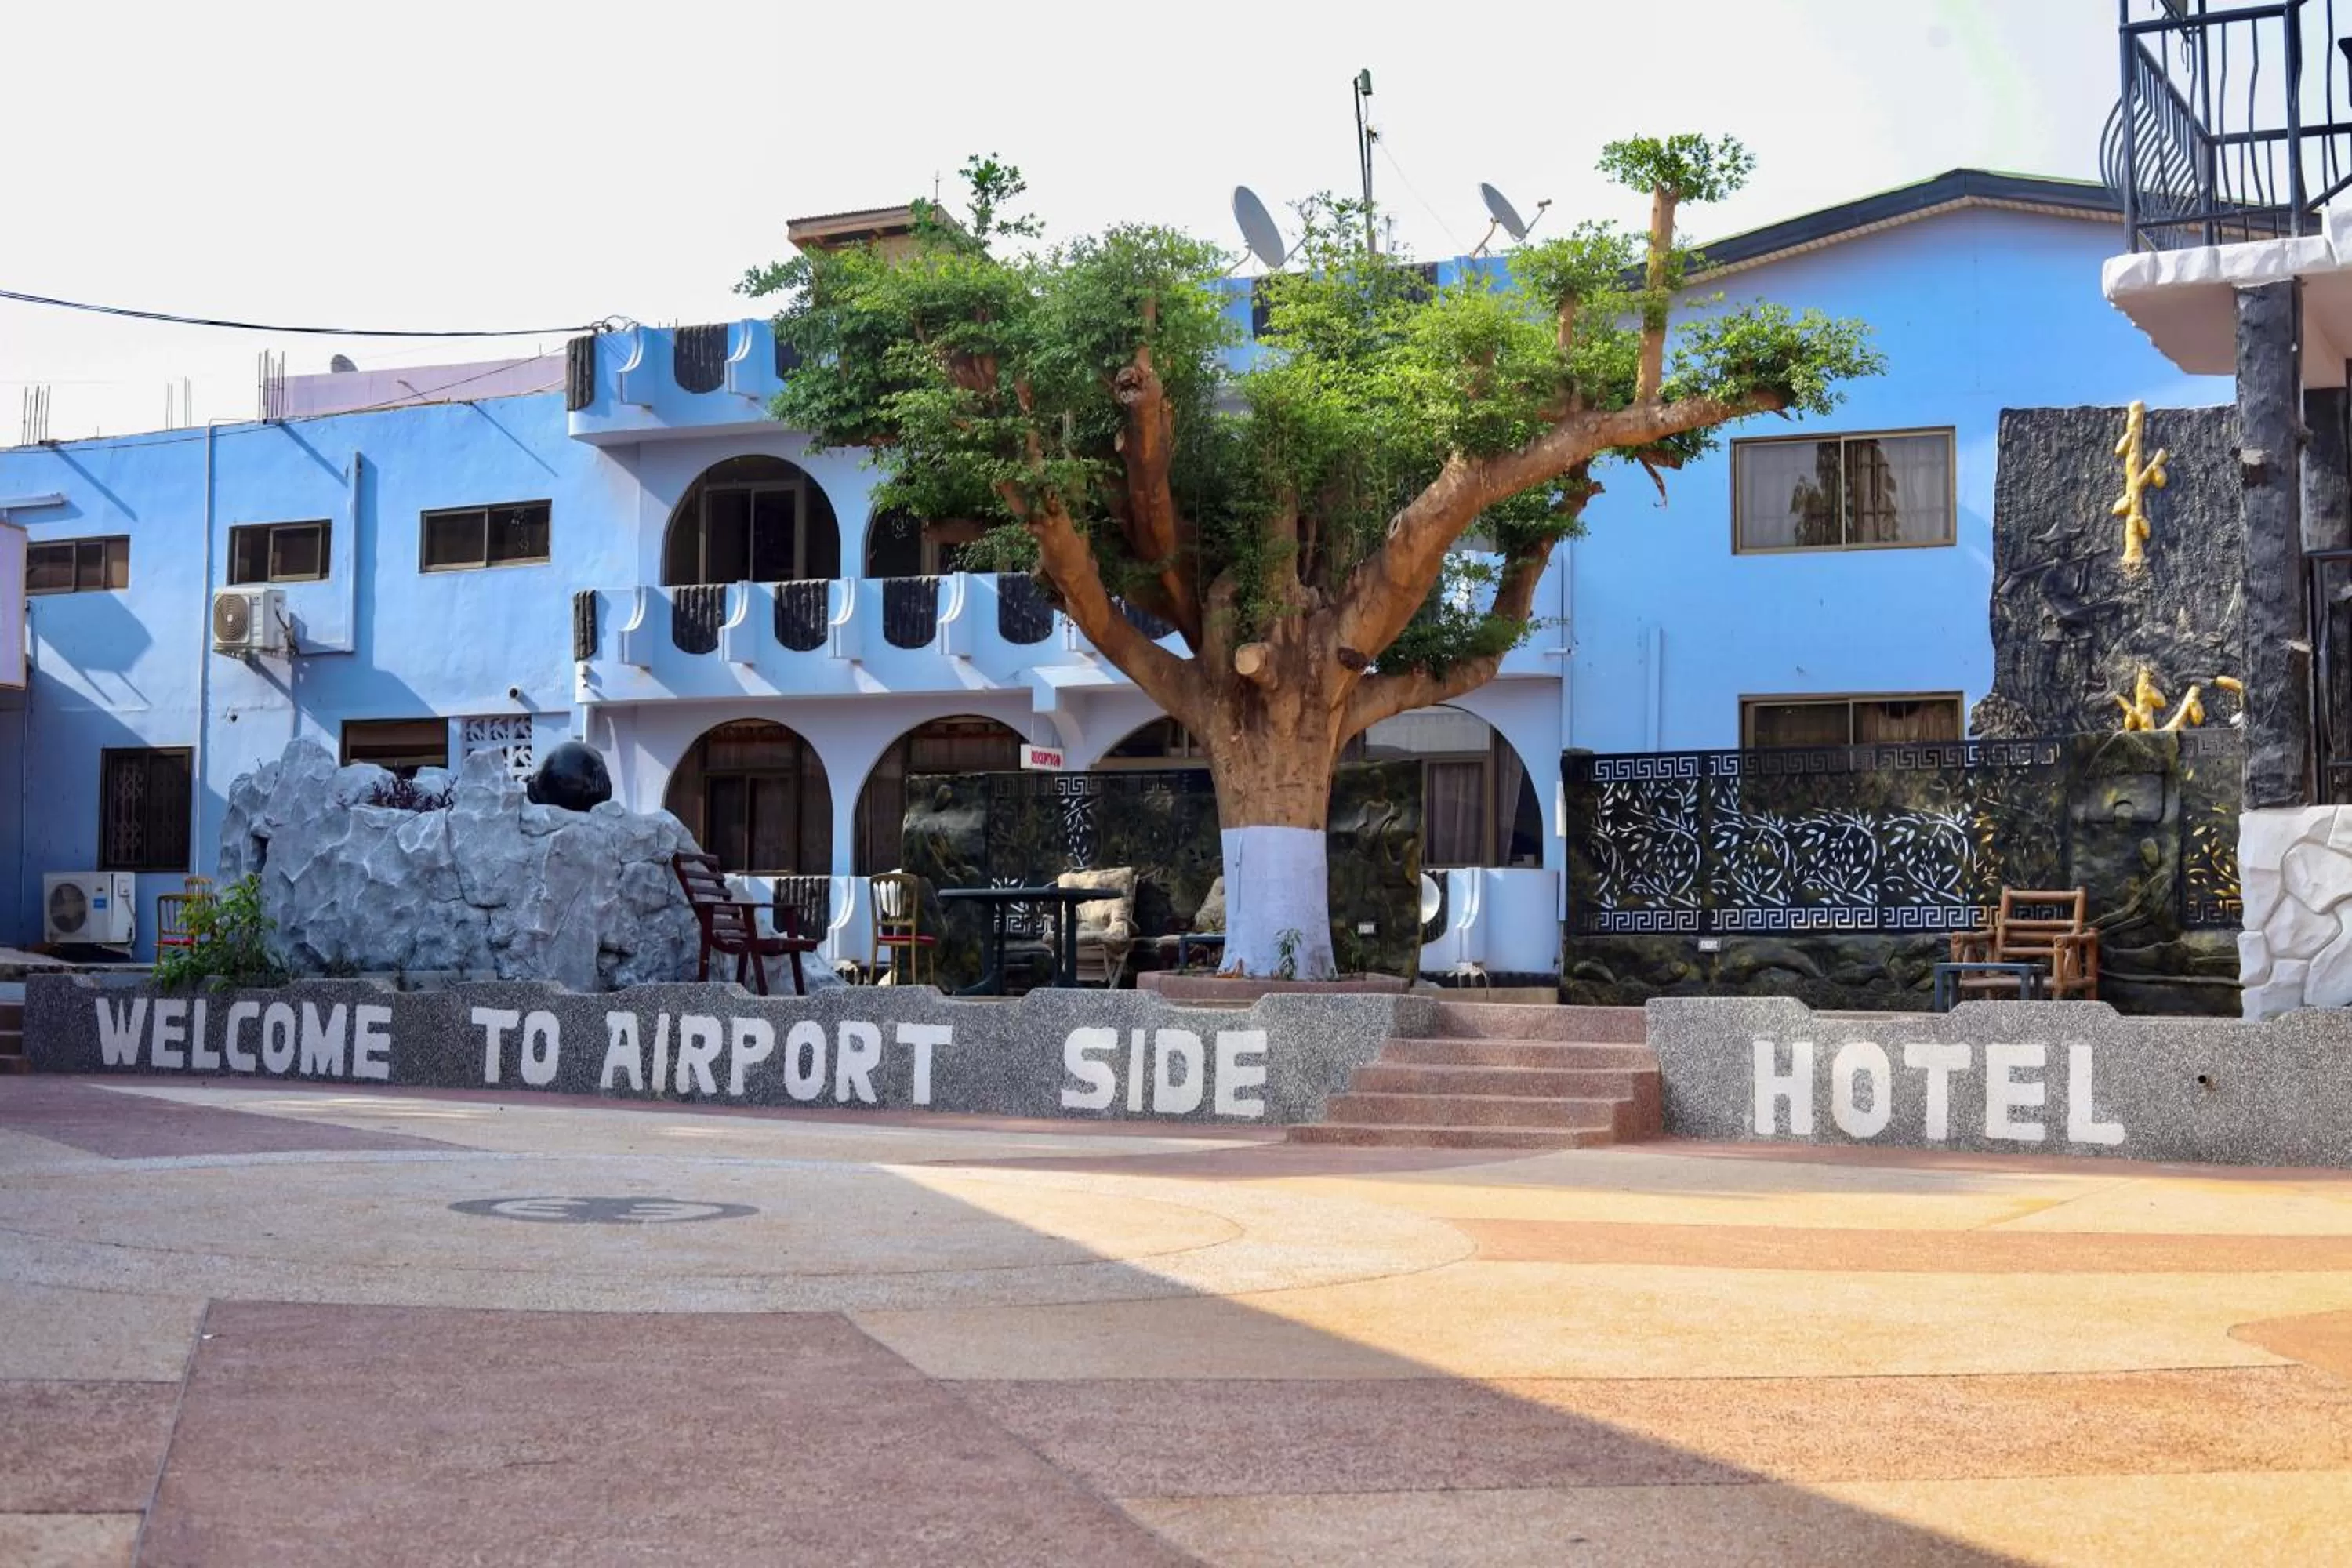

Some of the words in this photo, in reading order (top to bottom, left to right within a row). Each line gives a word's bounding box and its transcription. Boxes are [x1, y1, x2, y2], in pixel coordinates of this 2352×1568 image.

[95, 996, 392, 1080] WELCOME
[470, 1006, 561, 1086] TO
[599, 1010, 953, 1105] AIRPORT
[1061, 1026, 1268, 1117] SIDE
[1752, 1040, 2126, 1145] HOTEL
